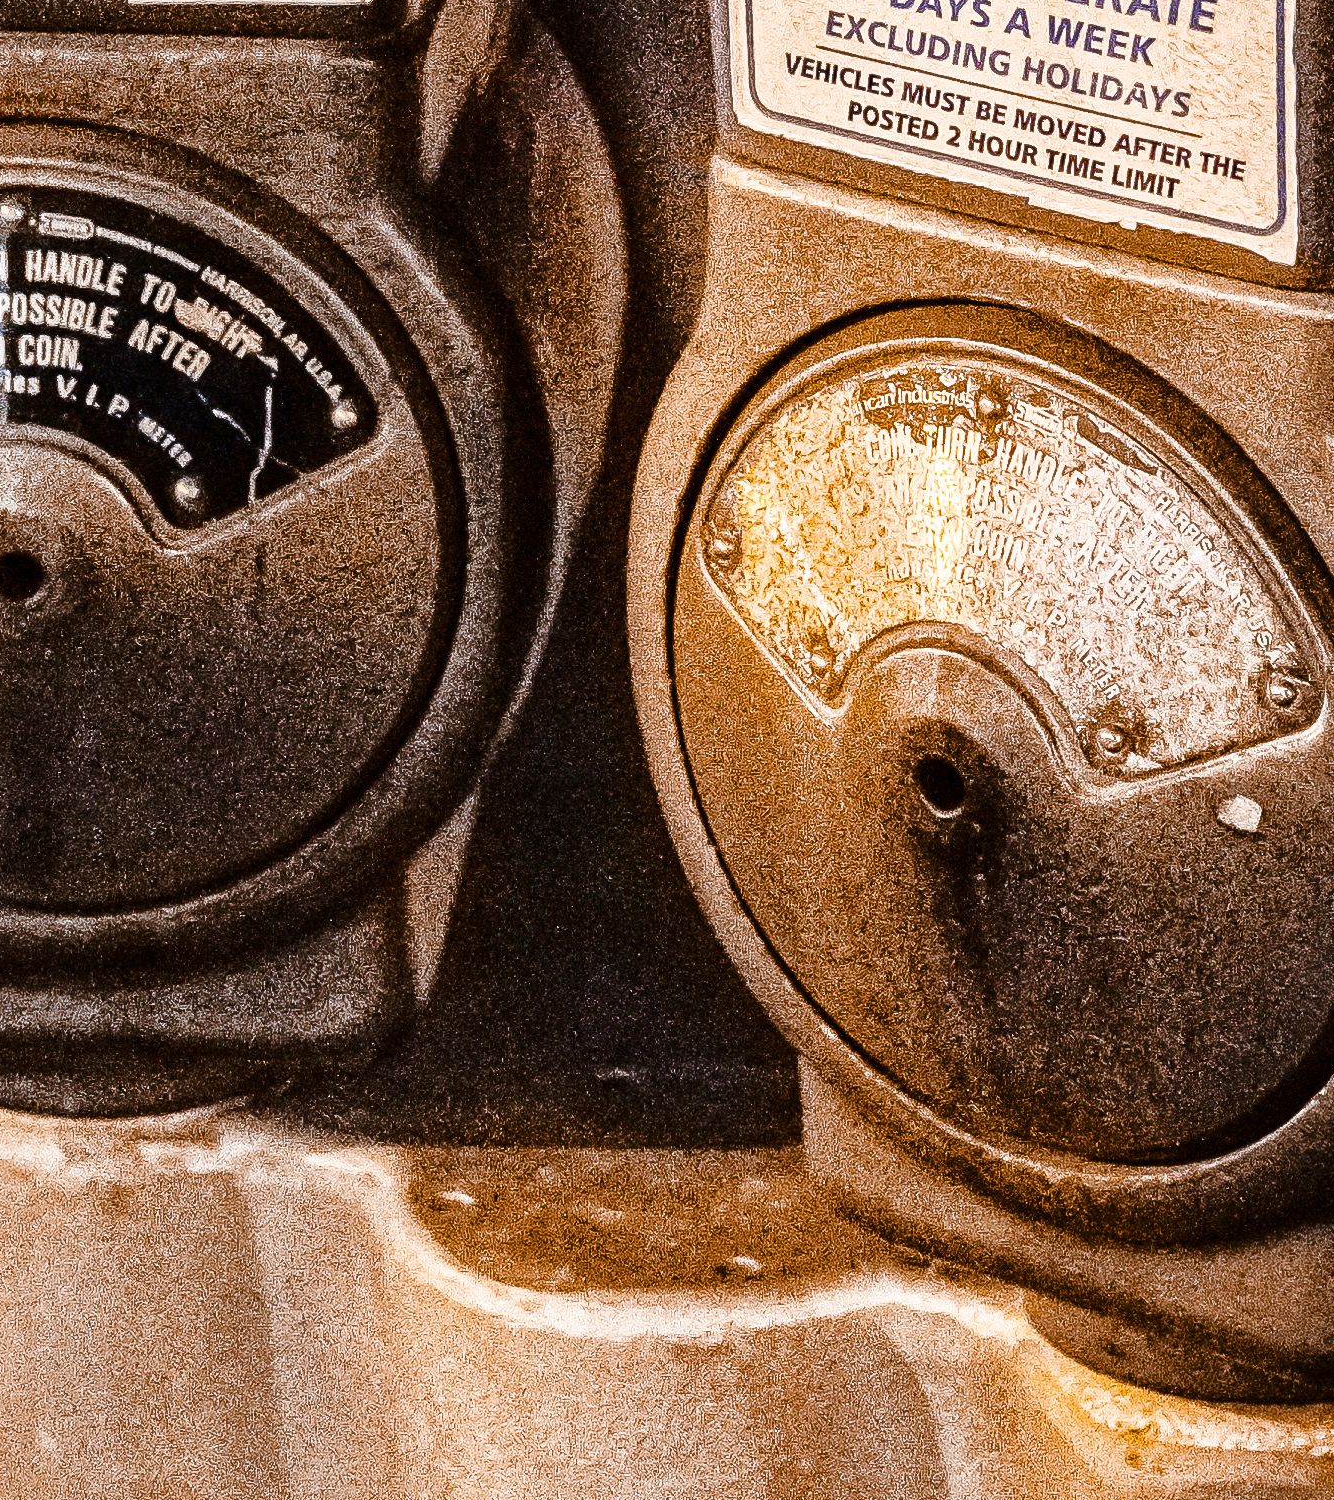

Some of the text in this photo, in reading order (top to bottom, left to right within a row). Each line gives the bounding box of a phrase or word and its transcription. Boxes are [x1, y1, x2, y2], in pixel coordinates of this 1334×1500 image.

[825, 10, 1192, 118] EXCLUDING HOLIDAYS
[1004, 7, 1031, 39] A
[1048, 14, 1157, 67] WEEK
[785, 51, 1247, 181] VEHICLES MUST BE MOVED AFTER THE
[847, 100, 1181, 199] POSTED 2 HOUR TIME LIMIT
[24, 249, 128, 297] HANDLE
[140, 273, 177, 314] TO
[127, 317, 212, 382] AFTER
